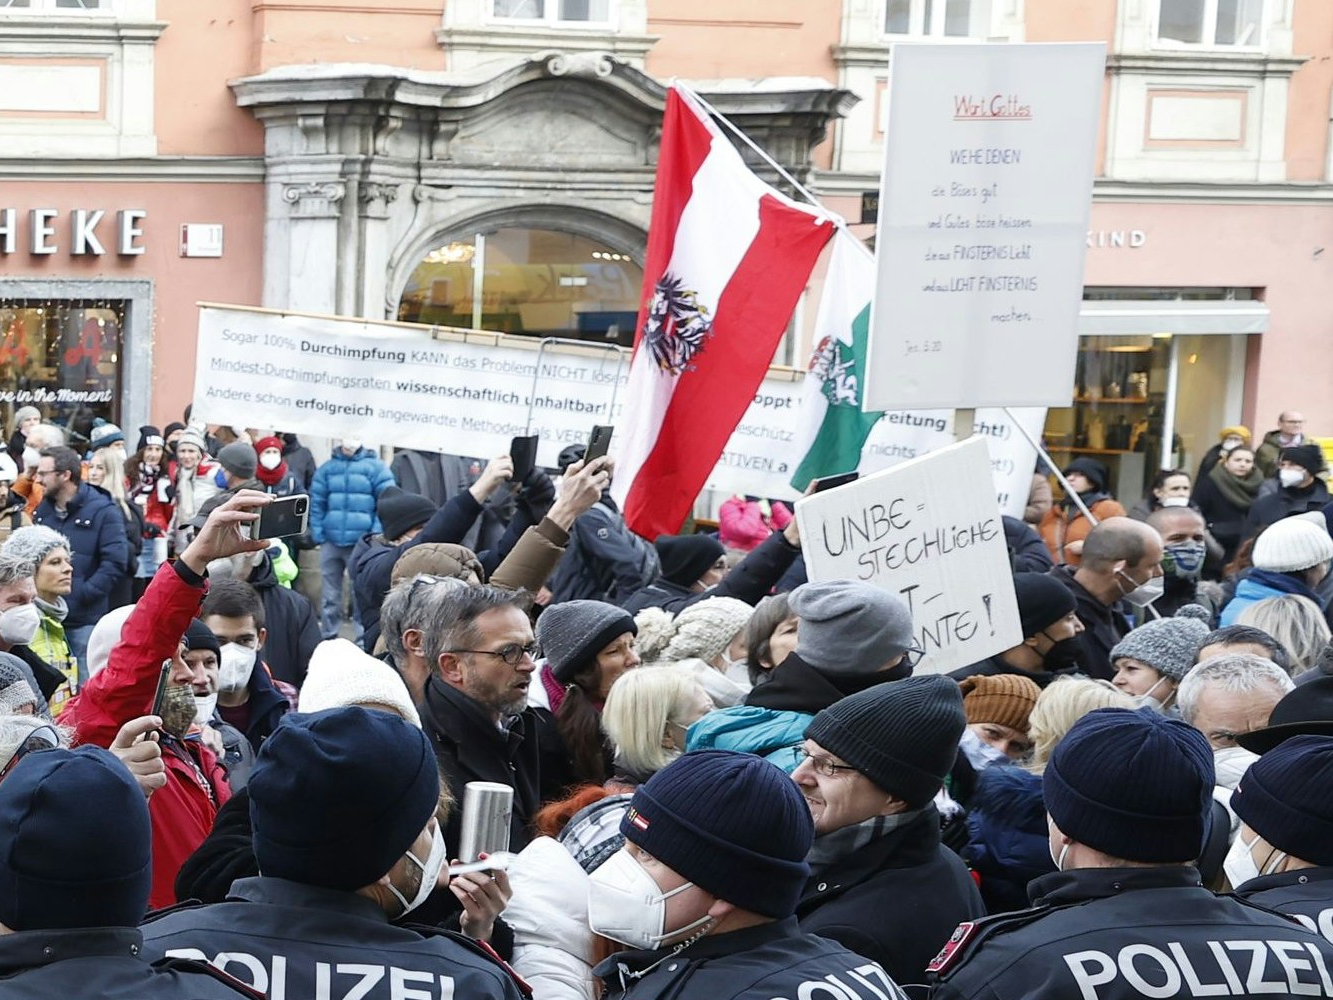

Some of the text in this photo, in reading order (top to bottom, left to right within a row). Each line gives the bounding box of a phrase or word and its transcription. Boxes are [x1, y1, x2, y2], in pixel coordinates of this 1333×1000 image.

[222, 328, 258, 346] Sogar
[263, 333, 296, 351] 100%
[300, 340, 406, 364] Durchimpfung
[410, 350, 449, 366] KANN
[453, 354, 476, 369] das
[482, 357, 536, 376] Problem
[542, 363, 587, 382] NICHT
[206, 386, 251, 402] Andere
[255, 391, 292, 407] schon
[296, 397, 374, 418] erfolgreich
[377, 407, 457, 428] angewandte
[461, 416, 529, 437] Methoden
[210, 357, 391, 390] Mindest-Durchimpfungsraten
[396, 380, 519, 405] wissenschaftlich
[524, 395, 607, 416] unhaltbar!
